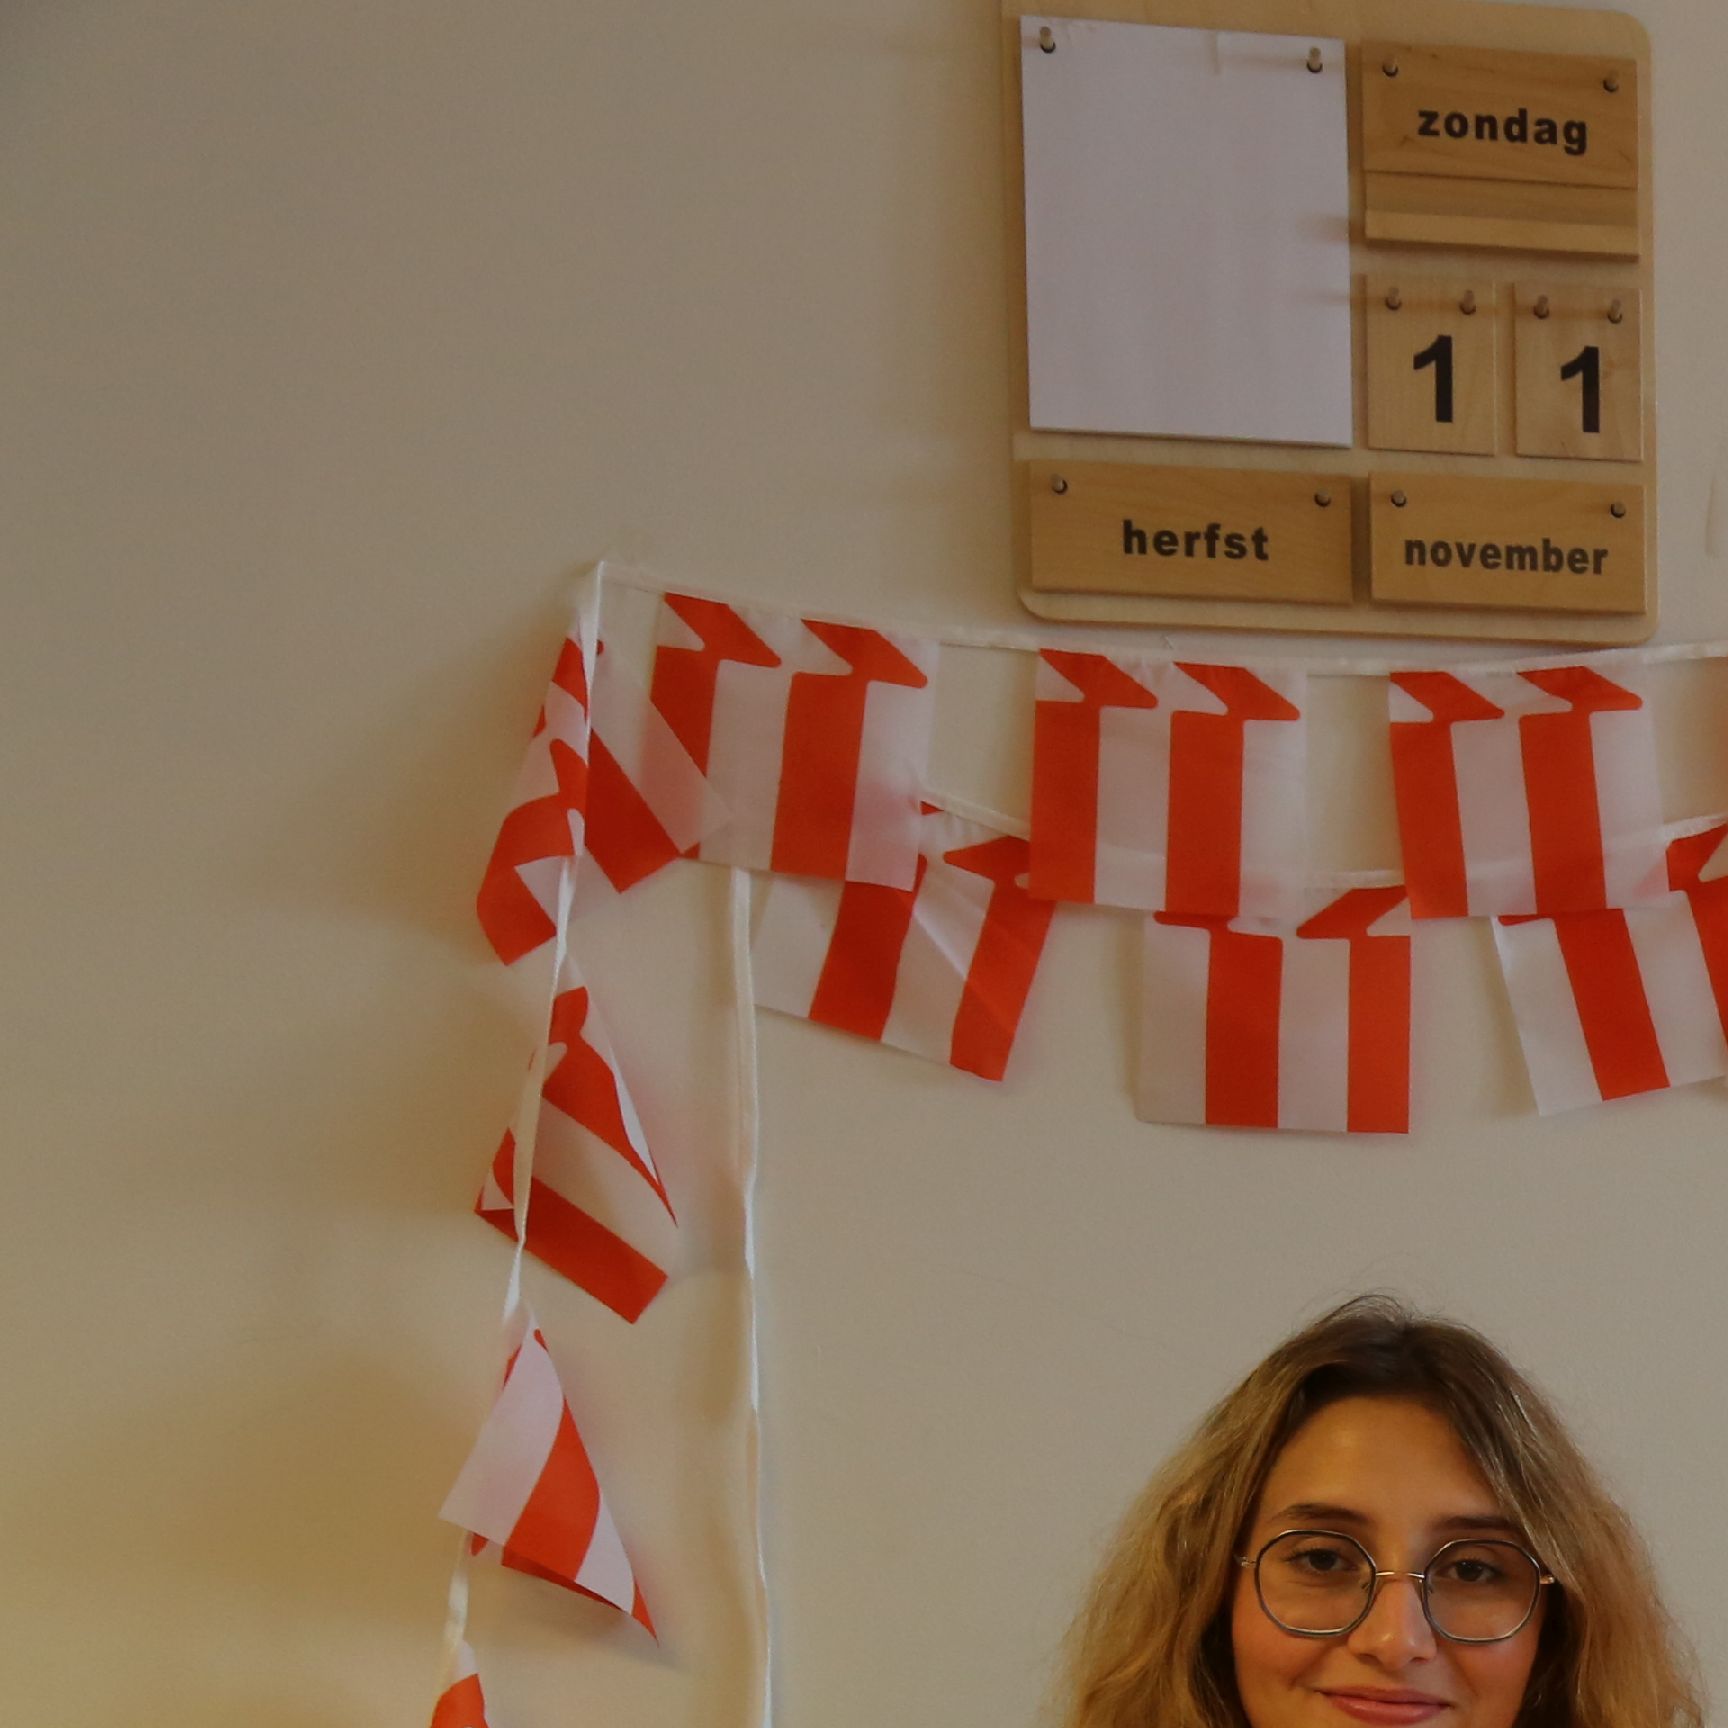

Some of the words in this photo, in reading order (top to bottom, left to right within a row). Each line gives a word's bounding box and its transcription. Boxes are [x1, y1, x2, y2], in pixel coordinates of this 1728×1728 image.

[1418, 107, 1588, 156] zondag
[1121, 518, 1270, 562] herfst
[1404, 537, 1608, 576] november
